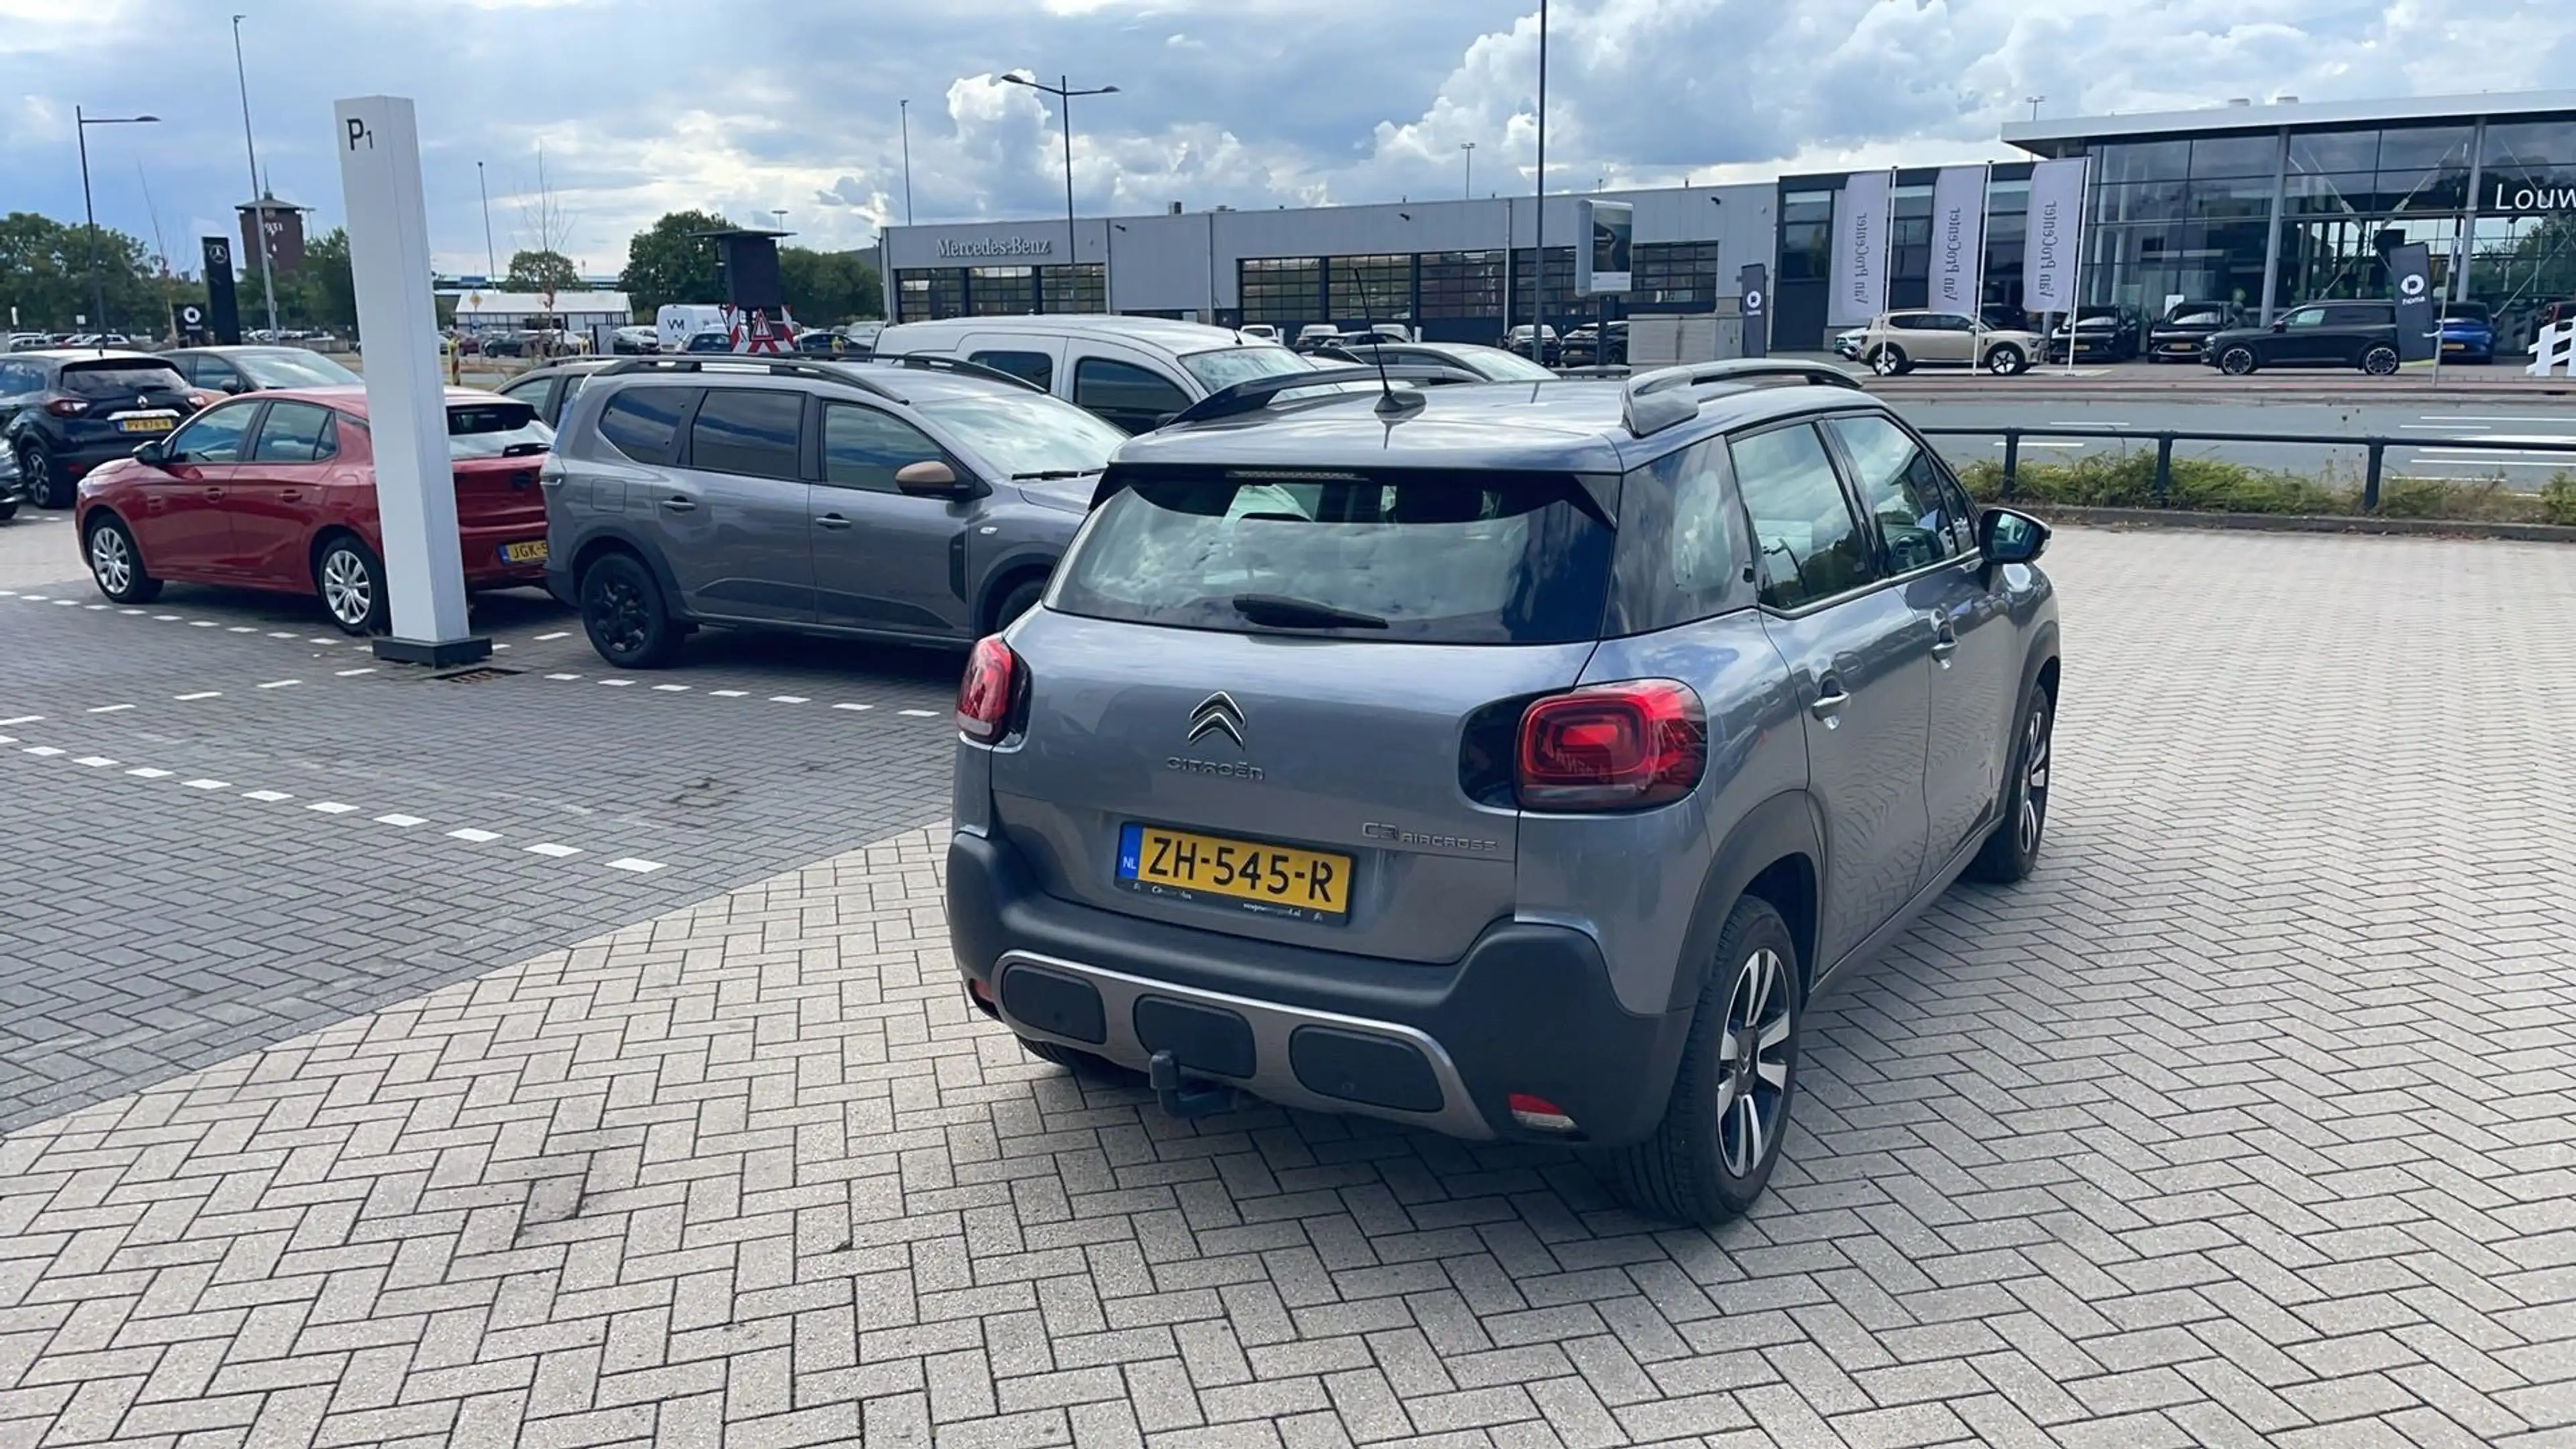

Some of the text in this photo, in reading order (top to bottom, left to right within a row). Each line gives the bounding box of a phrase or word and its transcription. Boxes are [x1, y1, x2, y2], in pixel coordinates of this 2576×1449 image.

[936, 236, 1051, 257] Mercedes-Benz
[1362, 822, 1499, 851] C3 AIRCROSS
[1122, 856, 1137, 870] NL
[1148, 837, 1333, 903] ZH-545-R
